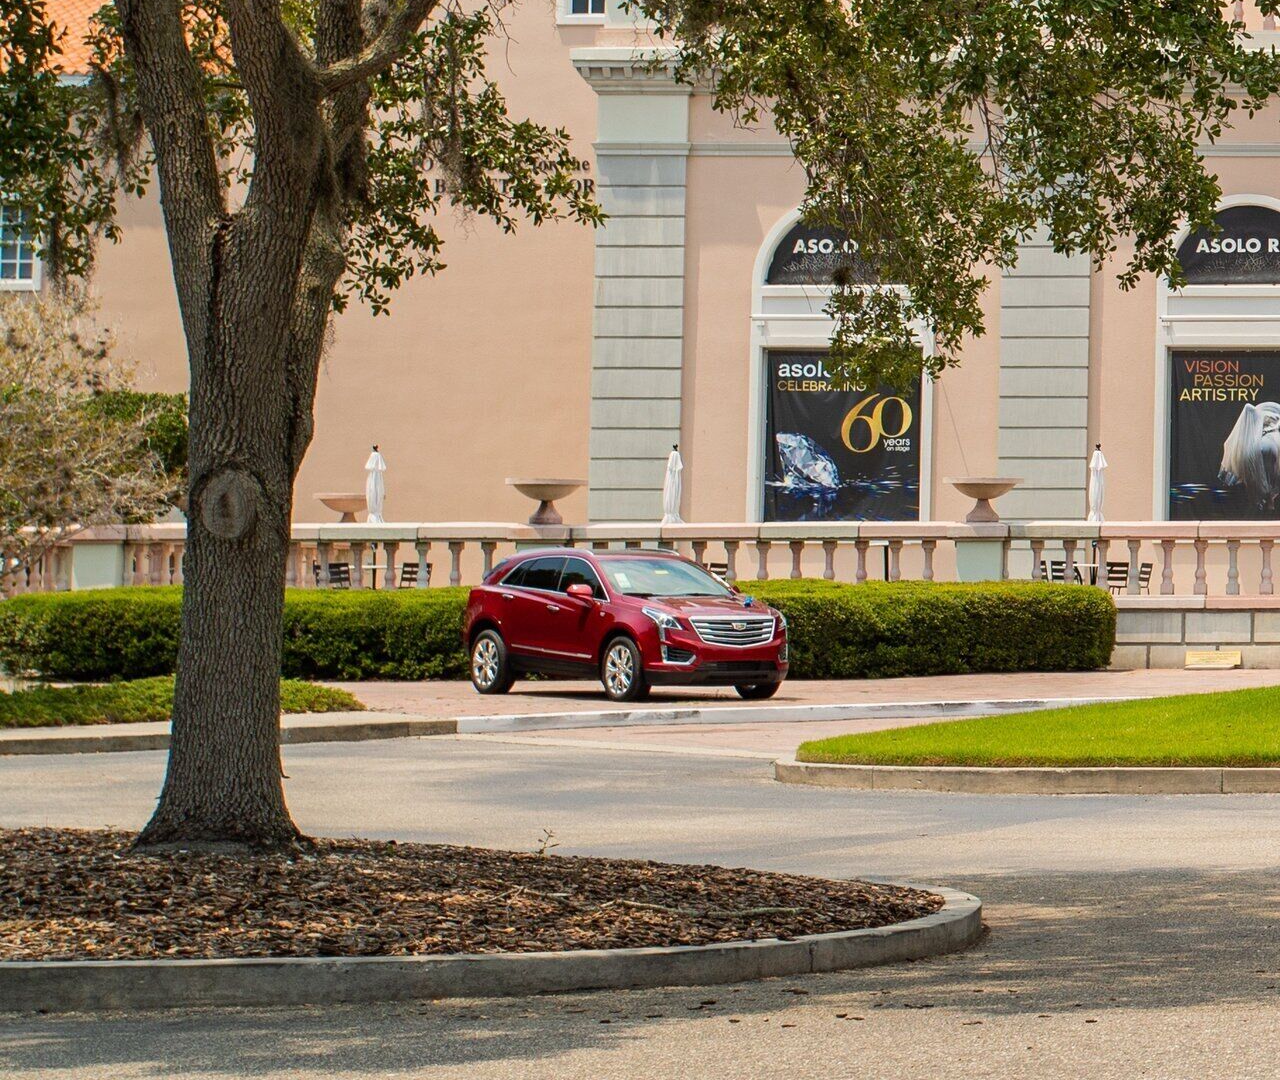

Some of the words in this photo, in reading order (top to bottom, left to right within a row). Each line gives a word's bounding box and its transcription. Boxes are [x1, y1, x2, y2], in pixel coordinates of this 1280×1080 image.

[793, 238, 859, 254] ASOO
[1196, 238, 1261, 254] ASOLO
[1184, 360, 1239, 373] VISION
[777, 380, 867, 392] CELEBRING
[1194, 374, 1263, 387] PASSION
[1180, 388, 1259, 401] ARTISTRY
[841, 393, 913, 453] 60
[883, 438, 911, 448] years
